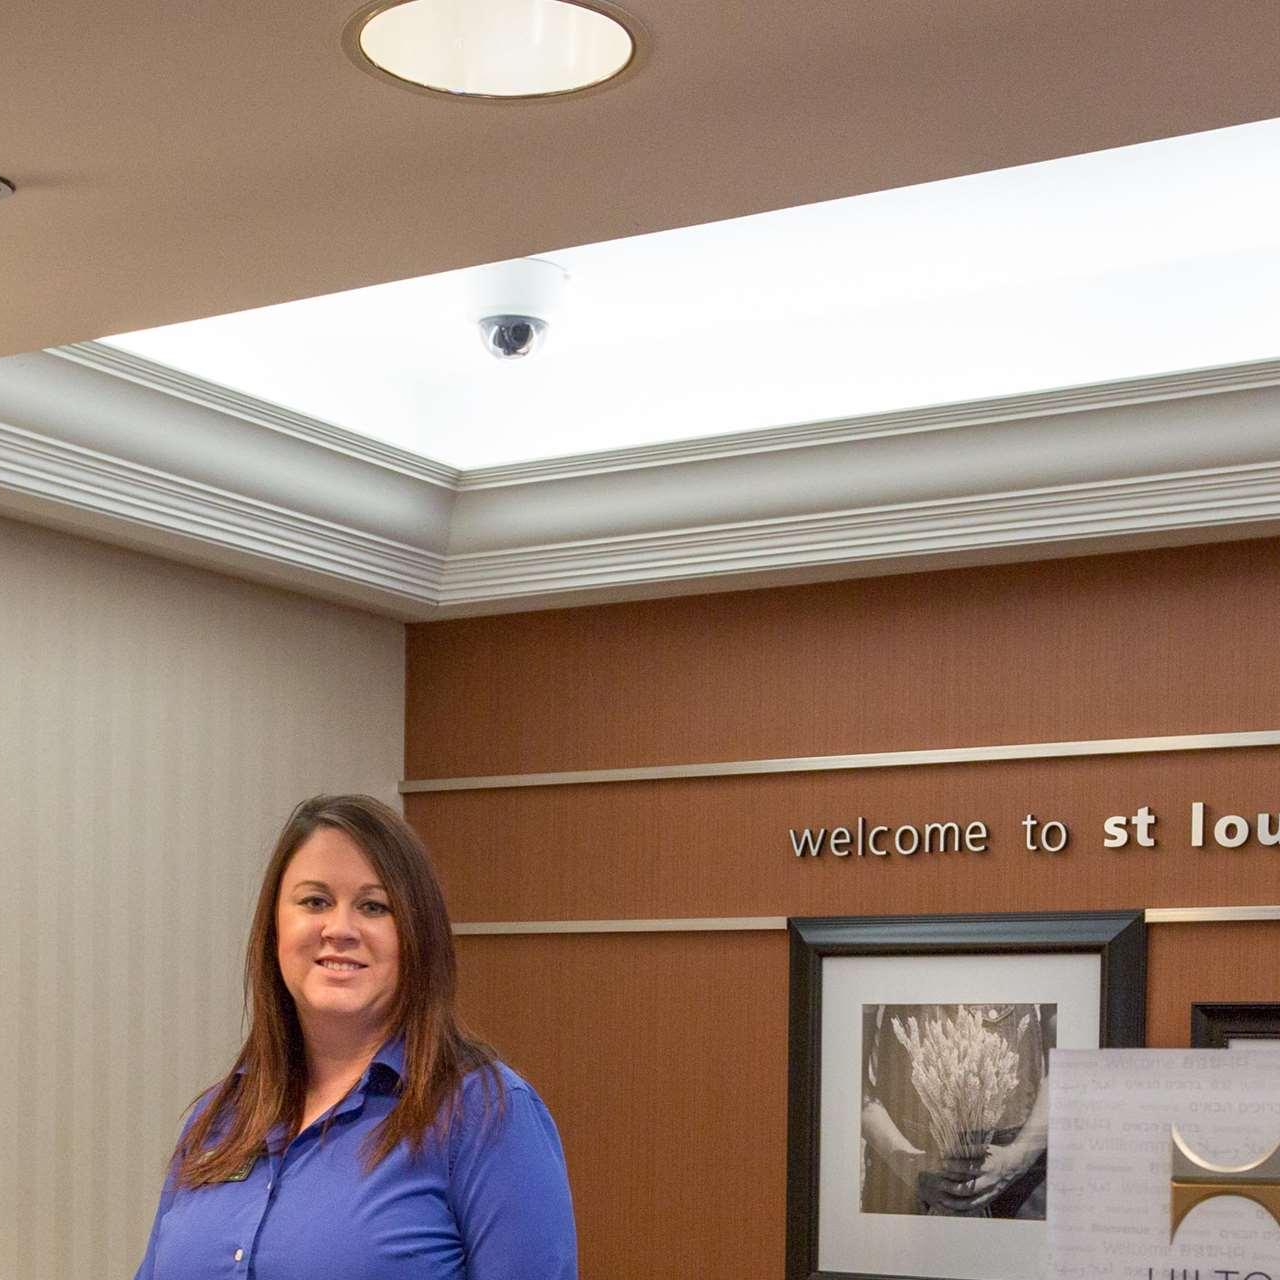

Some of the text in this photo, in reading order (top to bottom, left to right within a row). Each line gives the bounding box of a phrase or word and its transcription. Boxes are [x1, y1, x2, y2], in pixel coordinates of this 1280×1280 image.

[789, 816, 988, 858] welcome
[1021, 813, 1068, 853] to
[1103, 806, 1156, 848] st
